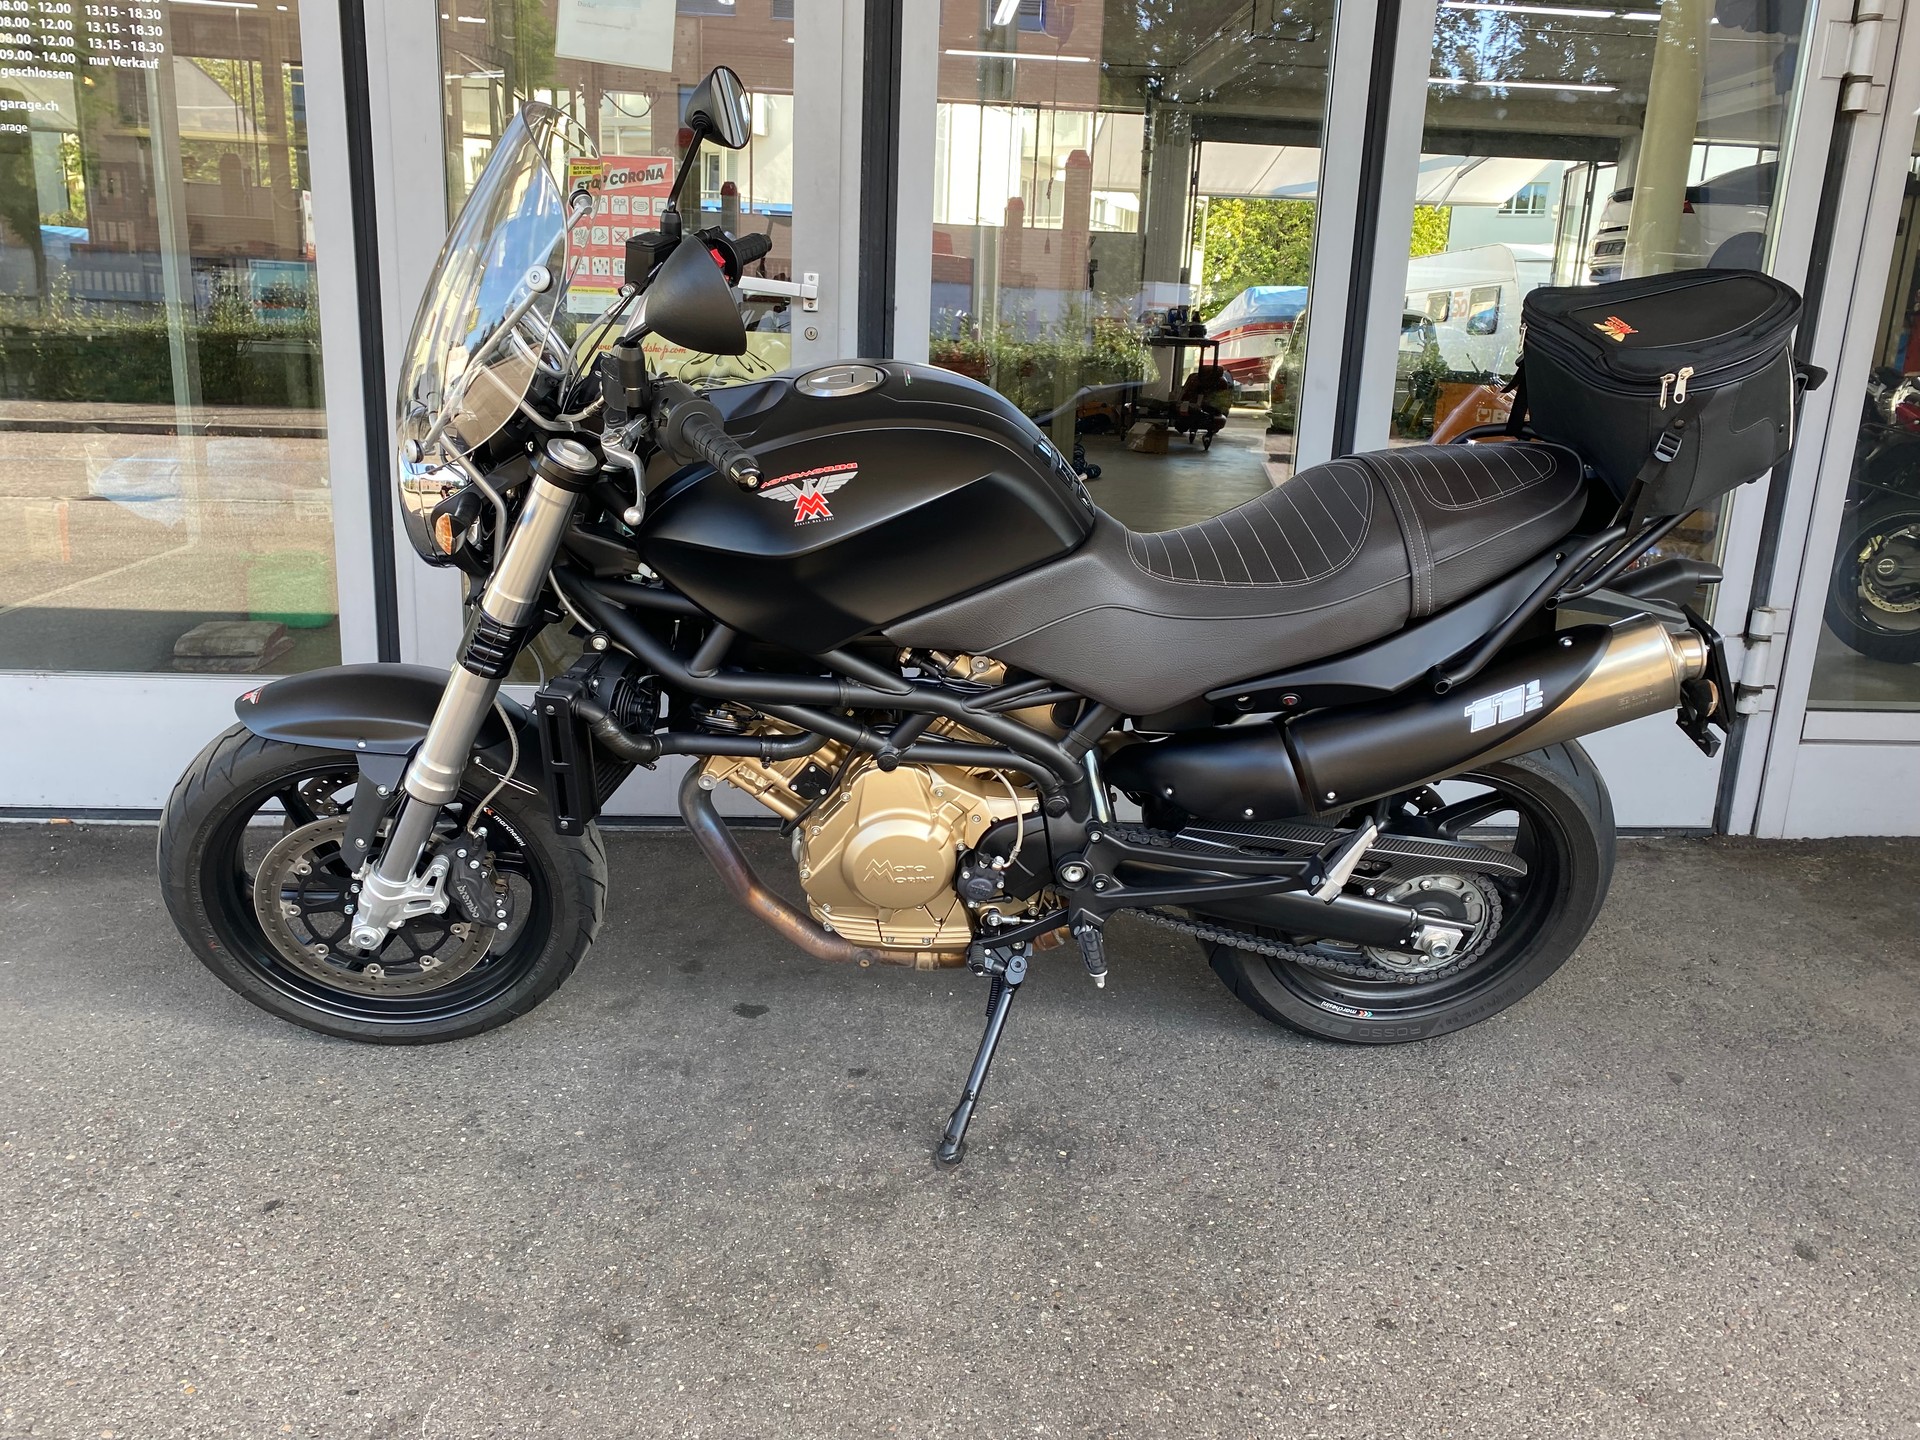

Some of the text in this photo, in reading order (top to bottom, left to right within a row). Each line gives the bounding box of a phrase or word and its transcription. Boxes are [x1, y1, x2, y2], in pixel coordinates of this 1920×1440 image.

[0, 0, 28, 12] 8.00
[38, 2, 71, 14] 12.00
[84, 4, 118, 17] 13.15
[128, 7, 162, 20] 18.30
[39, 18, 73, 31] 12.00
[86, 21, 120, 34] 13.15
[129, 24, 163, 37] 18.30
[40, 34, 75, 47] 12.00
[87, 37, 121, 50] 13.15
[130, 40, 165, 53] 18.30
[0, 48, 33, 61] 09.00
[42, 51, 76, 64] 14.00
[88, 55, 159, 69] nur Verkauf
[1, 66, 74, 80] geschlossen
[610, 168, 664, 185] CORONA
[493, 815, 527, 847] marchesini
[456, 884, 480, 919] brembo
[1320, 1000, 1358, 1015] marchesini
